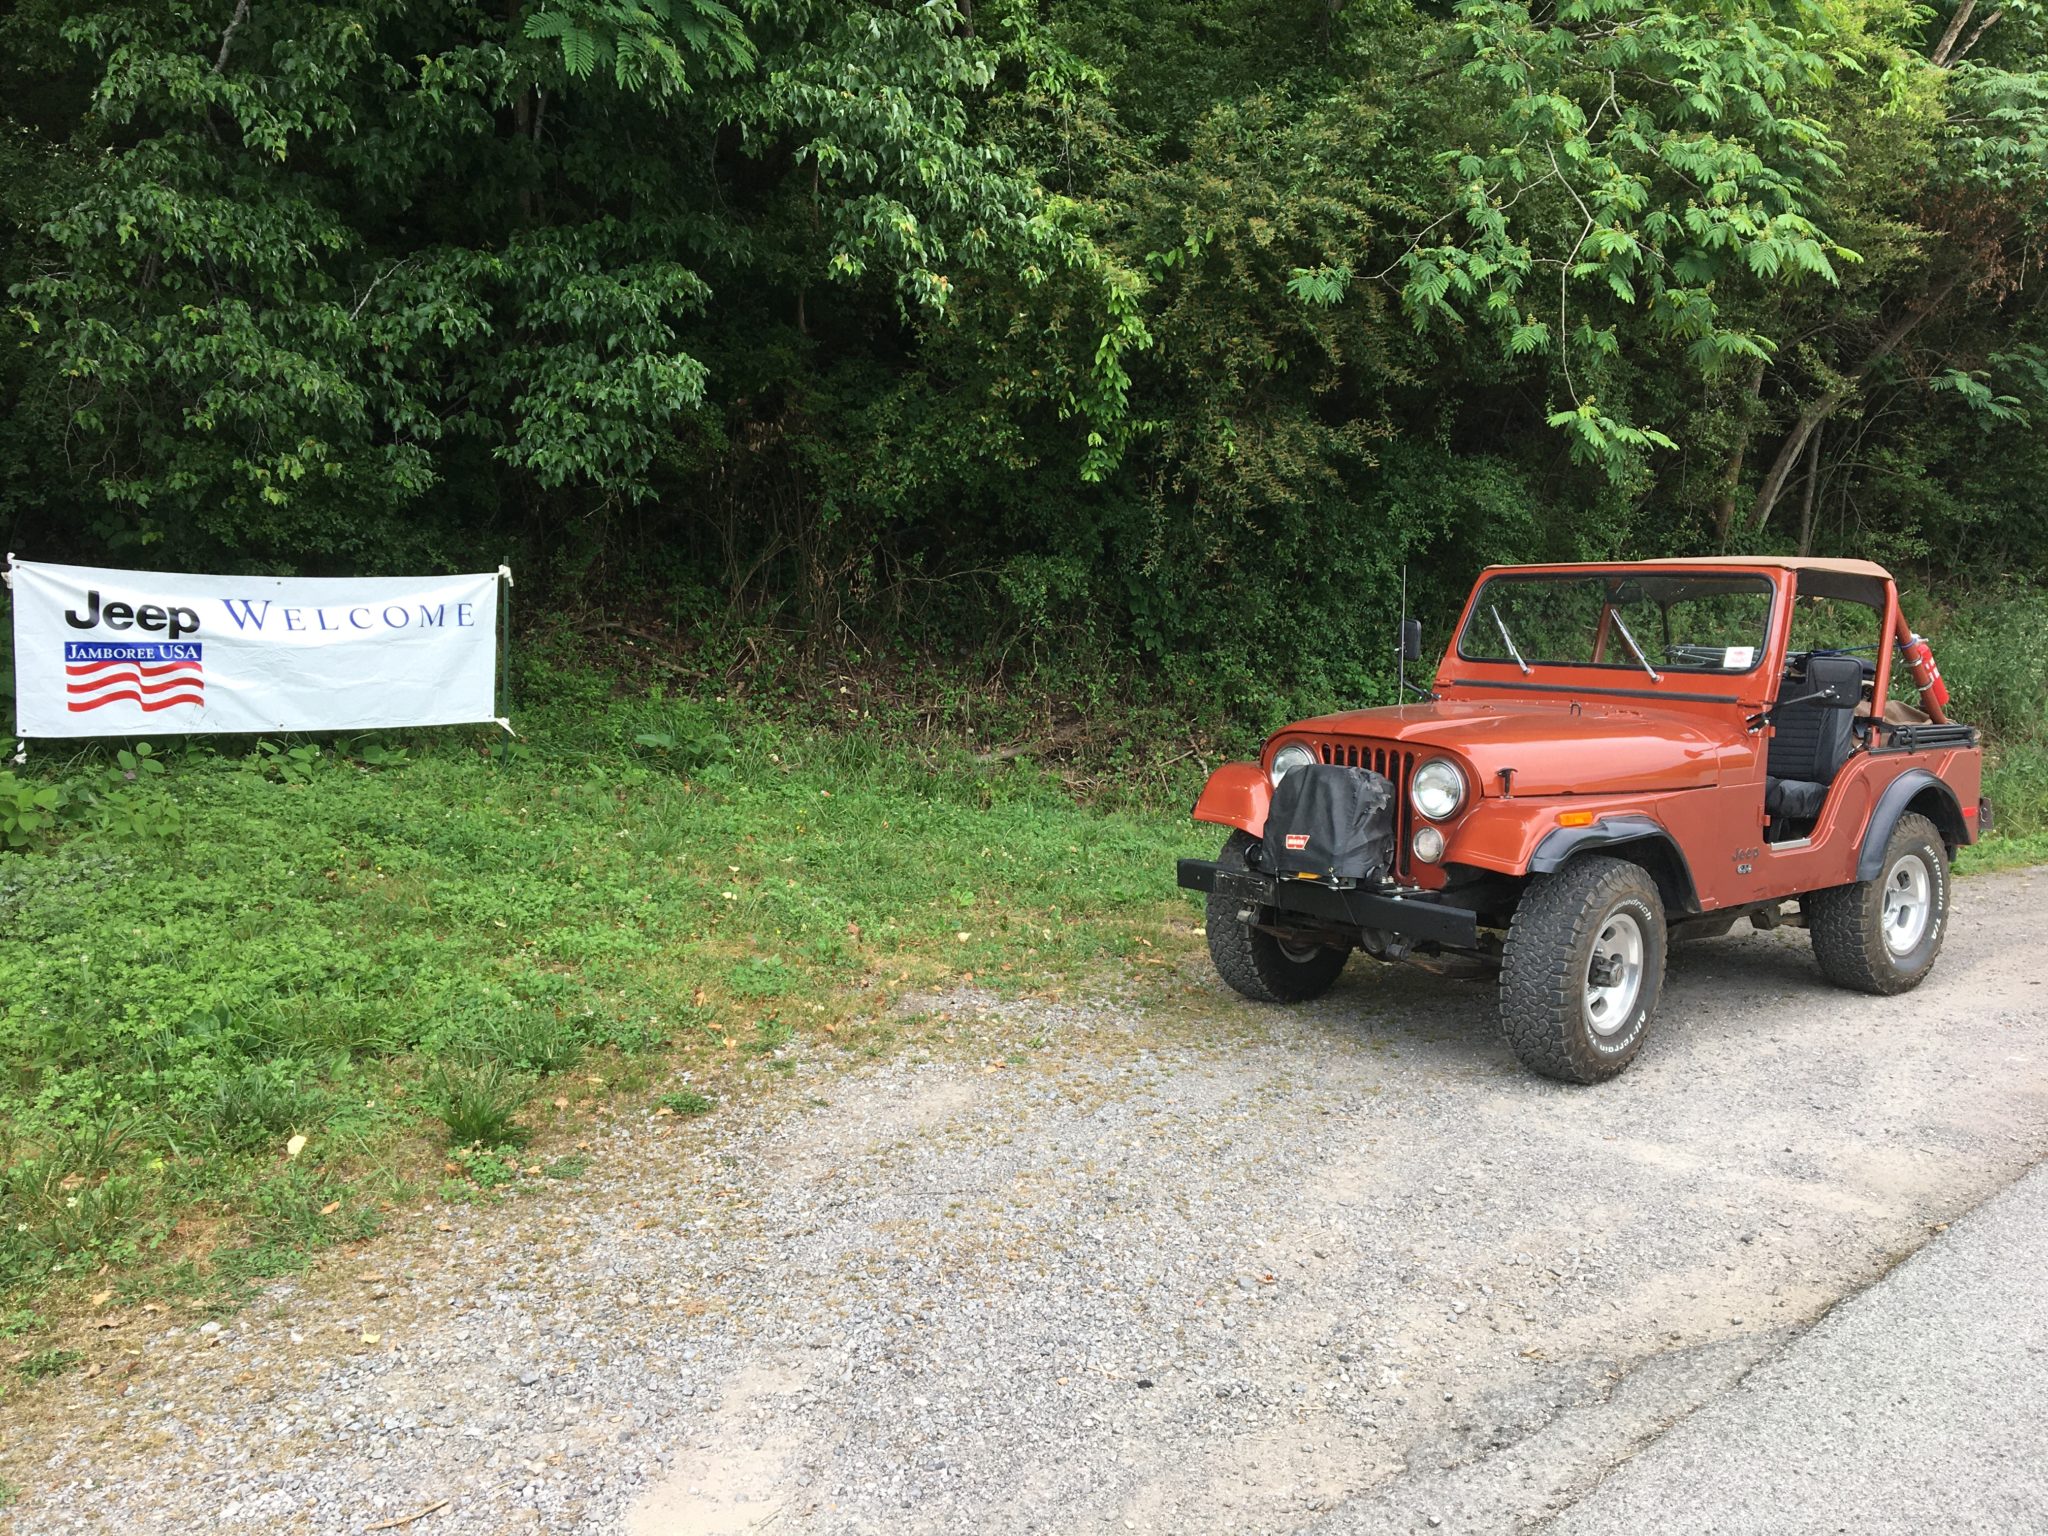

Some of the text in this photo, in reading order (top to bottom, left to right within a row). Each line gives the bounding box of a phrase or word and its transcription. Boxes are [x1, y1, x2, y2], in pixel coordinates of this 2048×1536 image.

[65, 590, 200, 639] Jeep
[220, 599, 475, 631] WELCOME
[68, 644, 199, 659] JAMBOREE USA
[1600, 1009, 1646, 1053] All-Terrain
